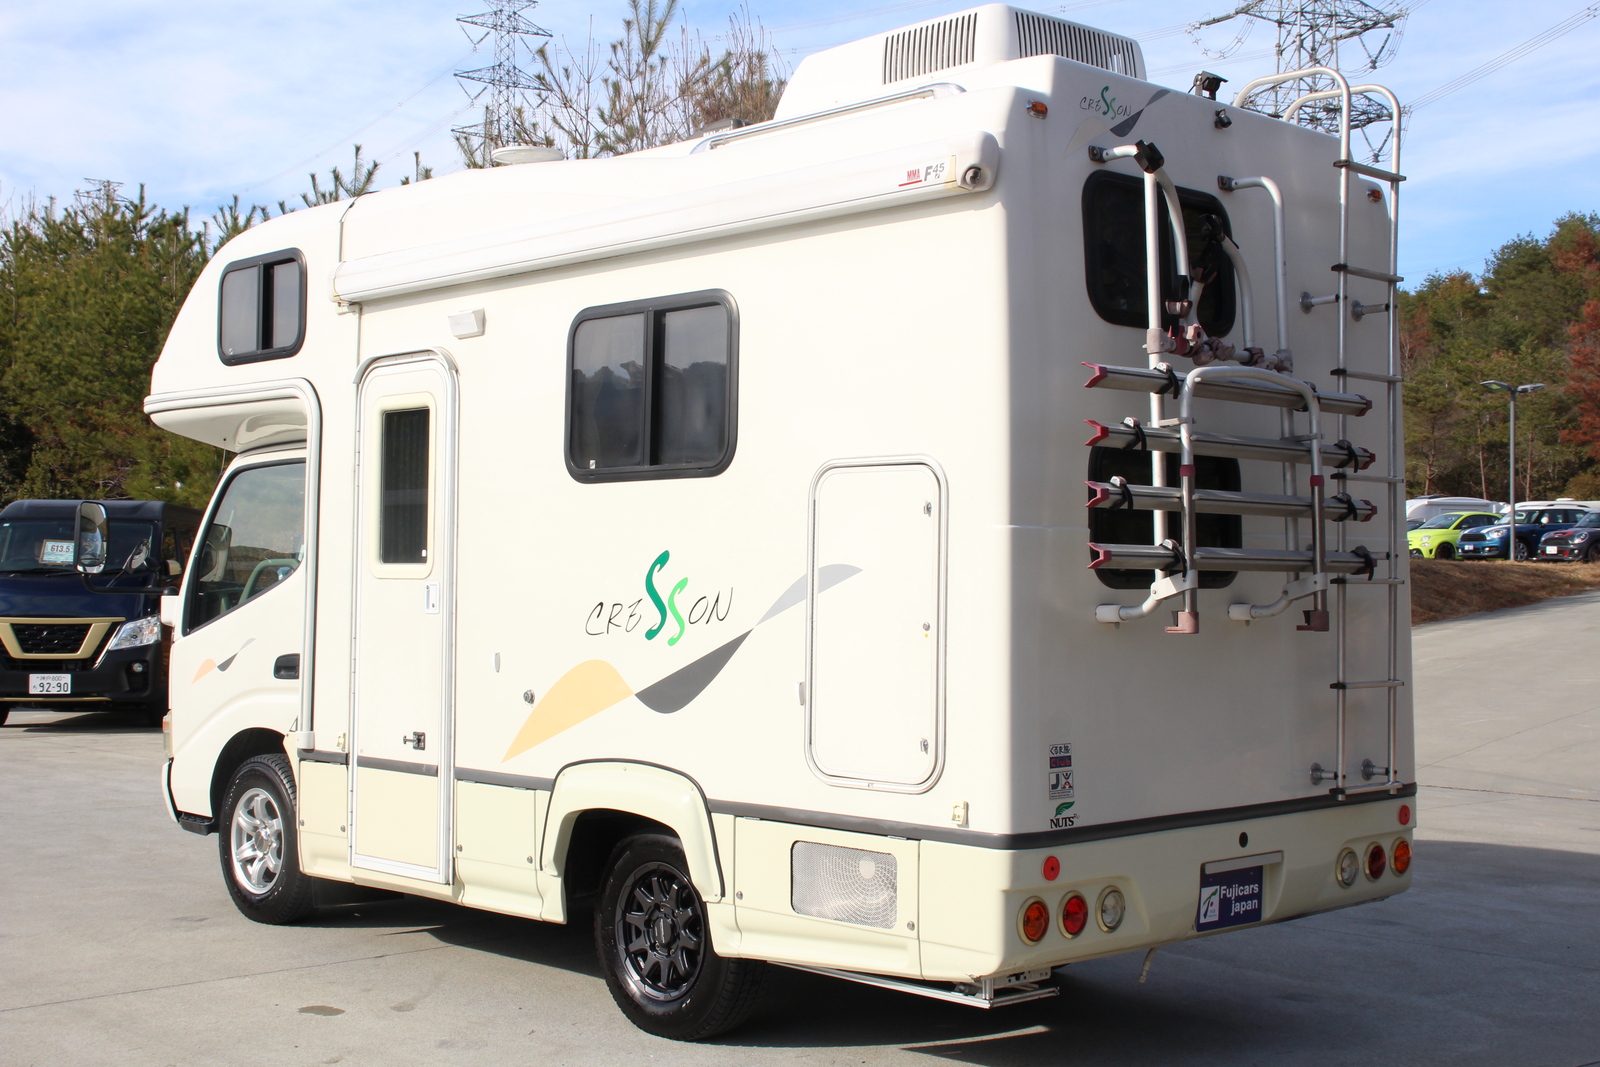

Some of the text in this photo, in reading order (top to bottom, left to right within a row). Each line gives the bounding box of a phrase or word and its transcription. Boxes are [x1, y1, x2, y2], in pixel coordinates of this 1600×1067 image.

[1080, 86, 1132, 120] CRESSON
[50, 544, 71, 553] 613.5
[585, 550, 733, 646] CRESSON
[38, 682, 69, 692] 92-90
[1049, 816, 1075, 830] NUTS
[1220, 883, 1260, 900] Fujicars
[1230, 899, 1259, 917] japan
